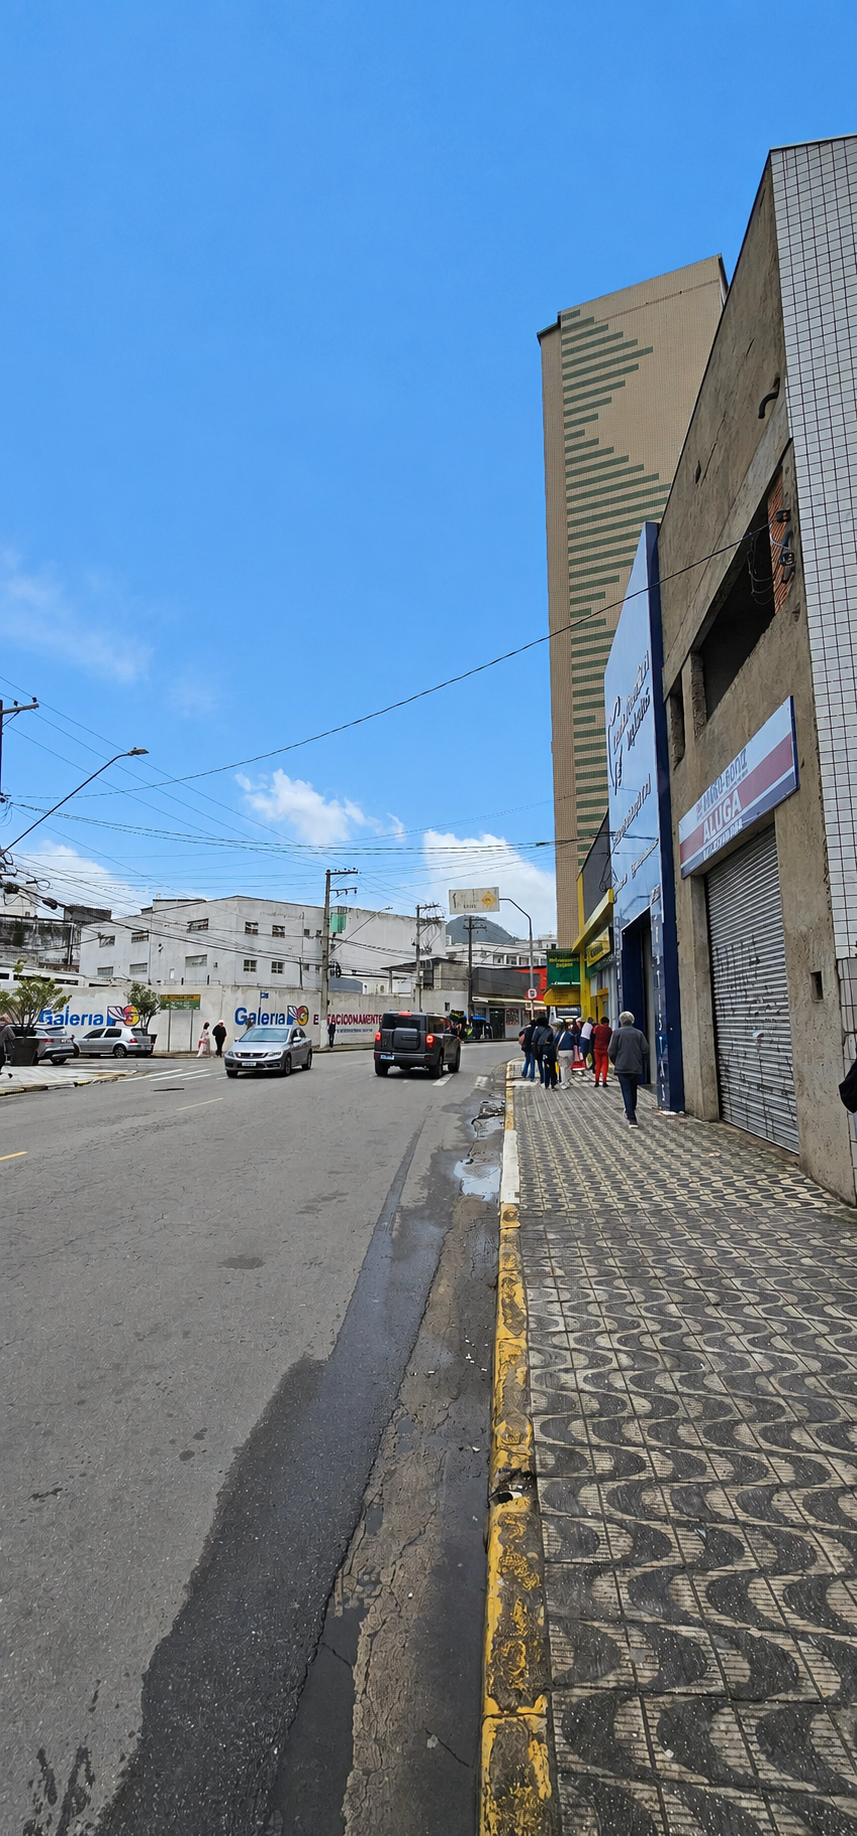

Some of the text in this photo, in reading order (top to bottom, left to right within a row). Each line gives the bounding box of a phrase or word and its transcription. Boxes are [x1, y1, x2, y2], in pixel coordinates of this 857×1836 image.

[702, 788, 742, 845] ALUGA
[38, 1005, 104, 1026] Galeria
[234, 1006, 286, 1026] Galeria
